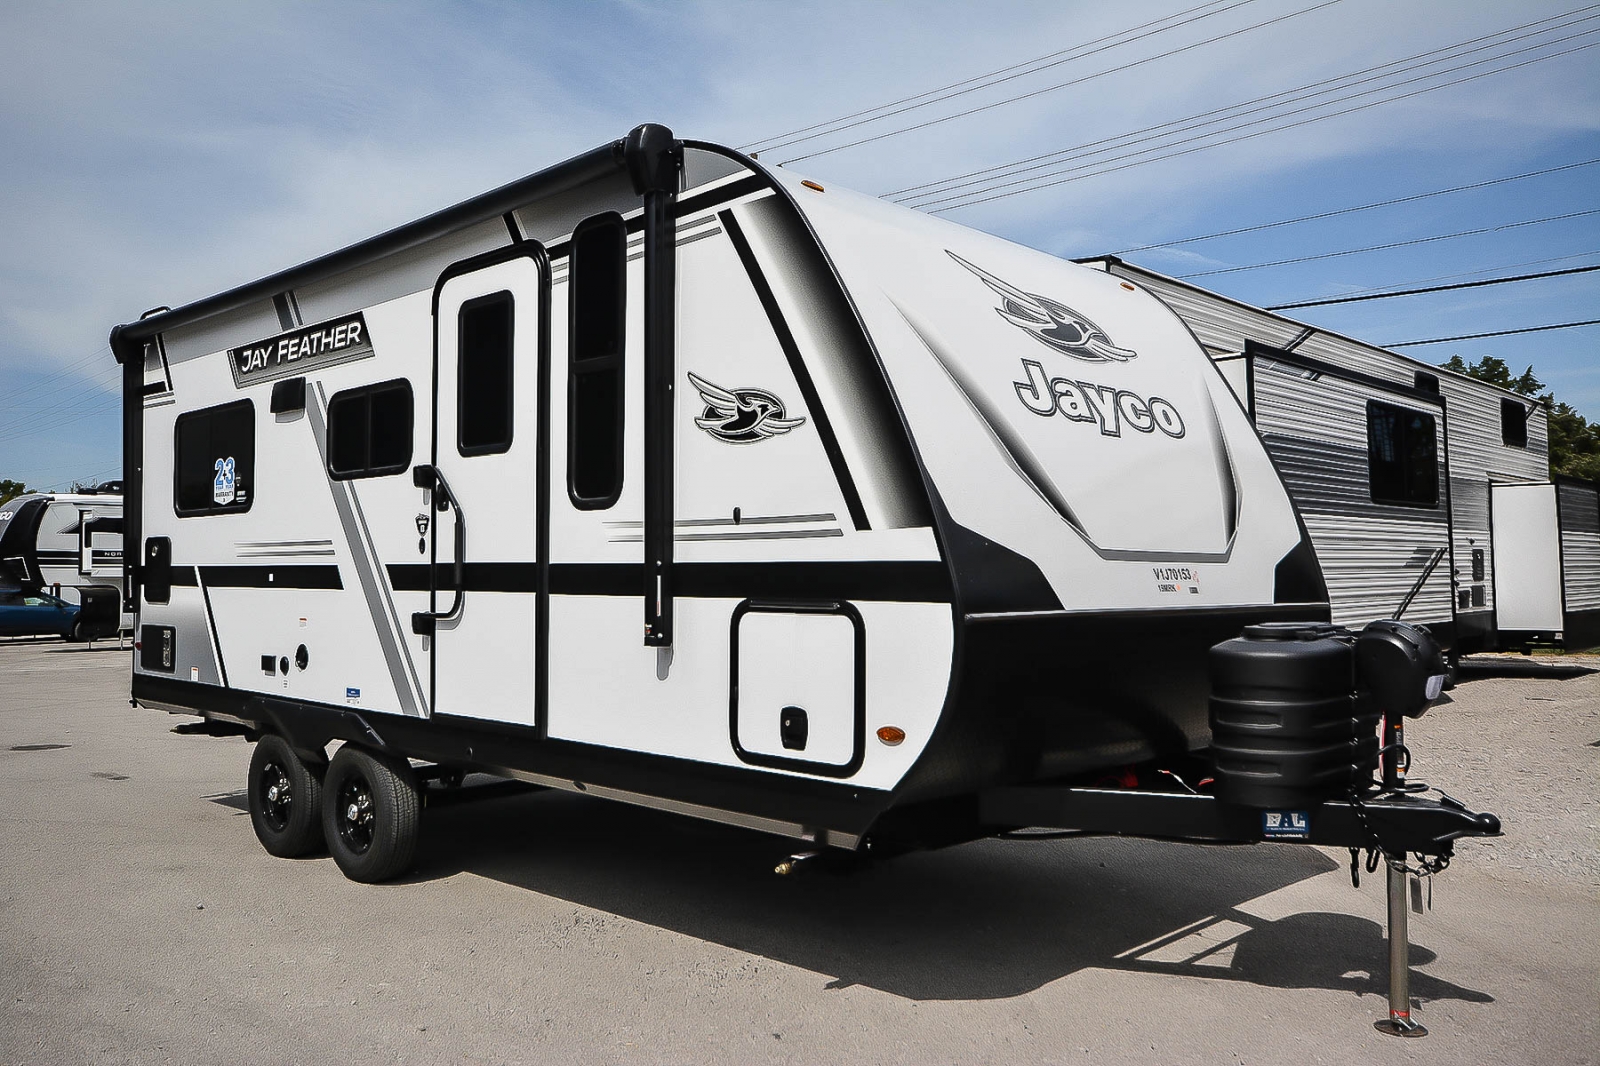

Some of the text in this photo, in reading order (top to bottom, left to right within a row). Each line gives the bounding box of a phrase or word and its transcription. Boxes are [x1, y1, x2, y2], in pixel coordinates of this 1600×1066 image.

[241, 321, 362, 373] JAY FEATHER
[1012, 357, 1187, 440] Jayco
